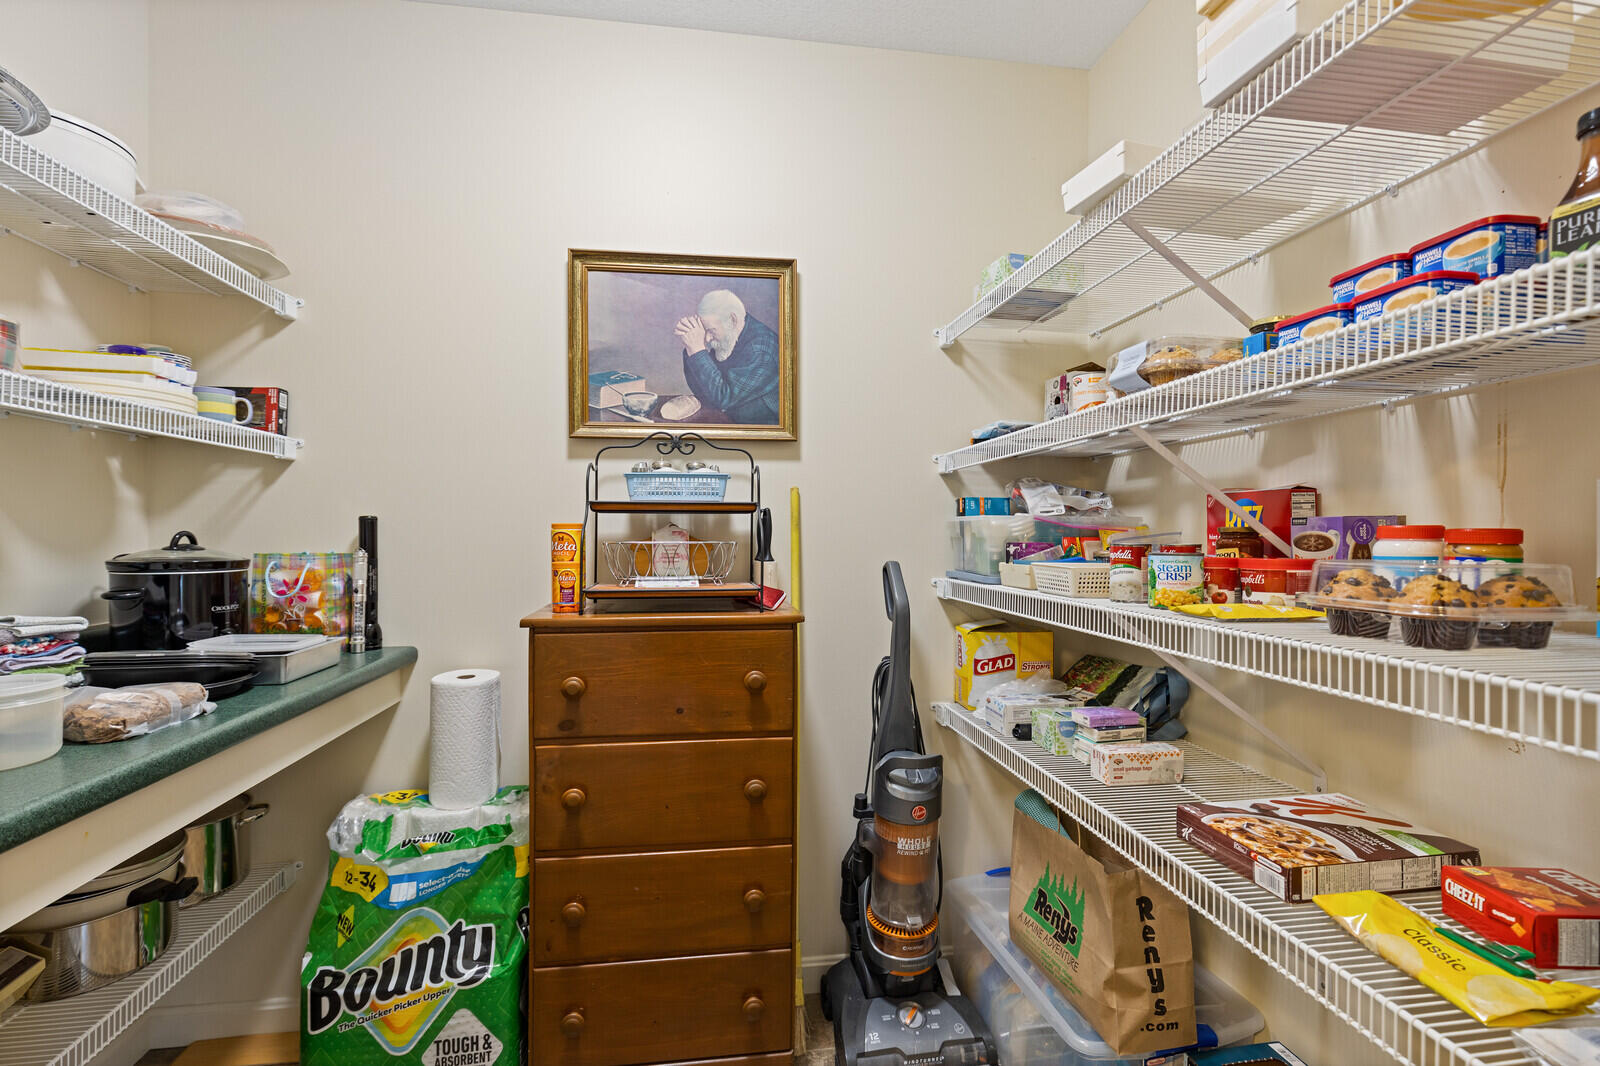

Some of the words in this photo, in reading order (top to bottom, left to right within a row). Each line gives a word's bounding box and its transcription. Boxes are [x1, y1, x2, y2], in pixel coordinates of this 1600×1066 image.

[1415, 247, 1442, 262] MAXWELL
[1157, 564, 1192, 573] steam
[1157, 572, 1192, 581] CRISP
[977, 657, 1014, 673] GLAD
[897, 836, 931, 844] WHOLE
[1017, 912, 1024, 921] A
[1023, 917, 1044, 941] MAINE
[1043, 932, 1079, 973] ADVENTURE
[1403, 928, 1467, 972] Classic
[309, 920, 494, 1033] Bounty
[338, 1021, 355, 1032] The
[357, 1008, 392, 1025] Quicker
[394, 999, 421, 1012] Picker
[423, 987, 451, 1001] Upper
[434, 1035, 479, 1056] TOUGH
[483, 1033, 492, 1050] &
[869, 1032, 880, 1041] 12
[434, 1050, 492, 1066] ABSORBENT
